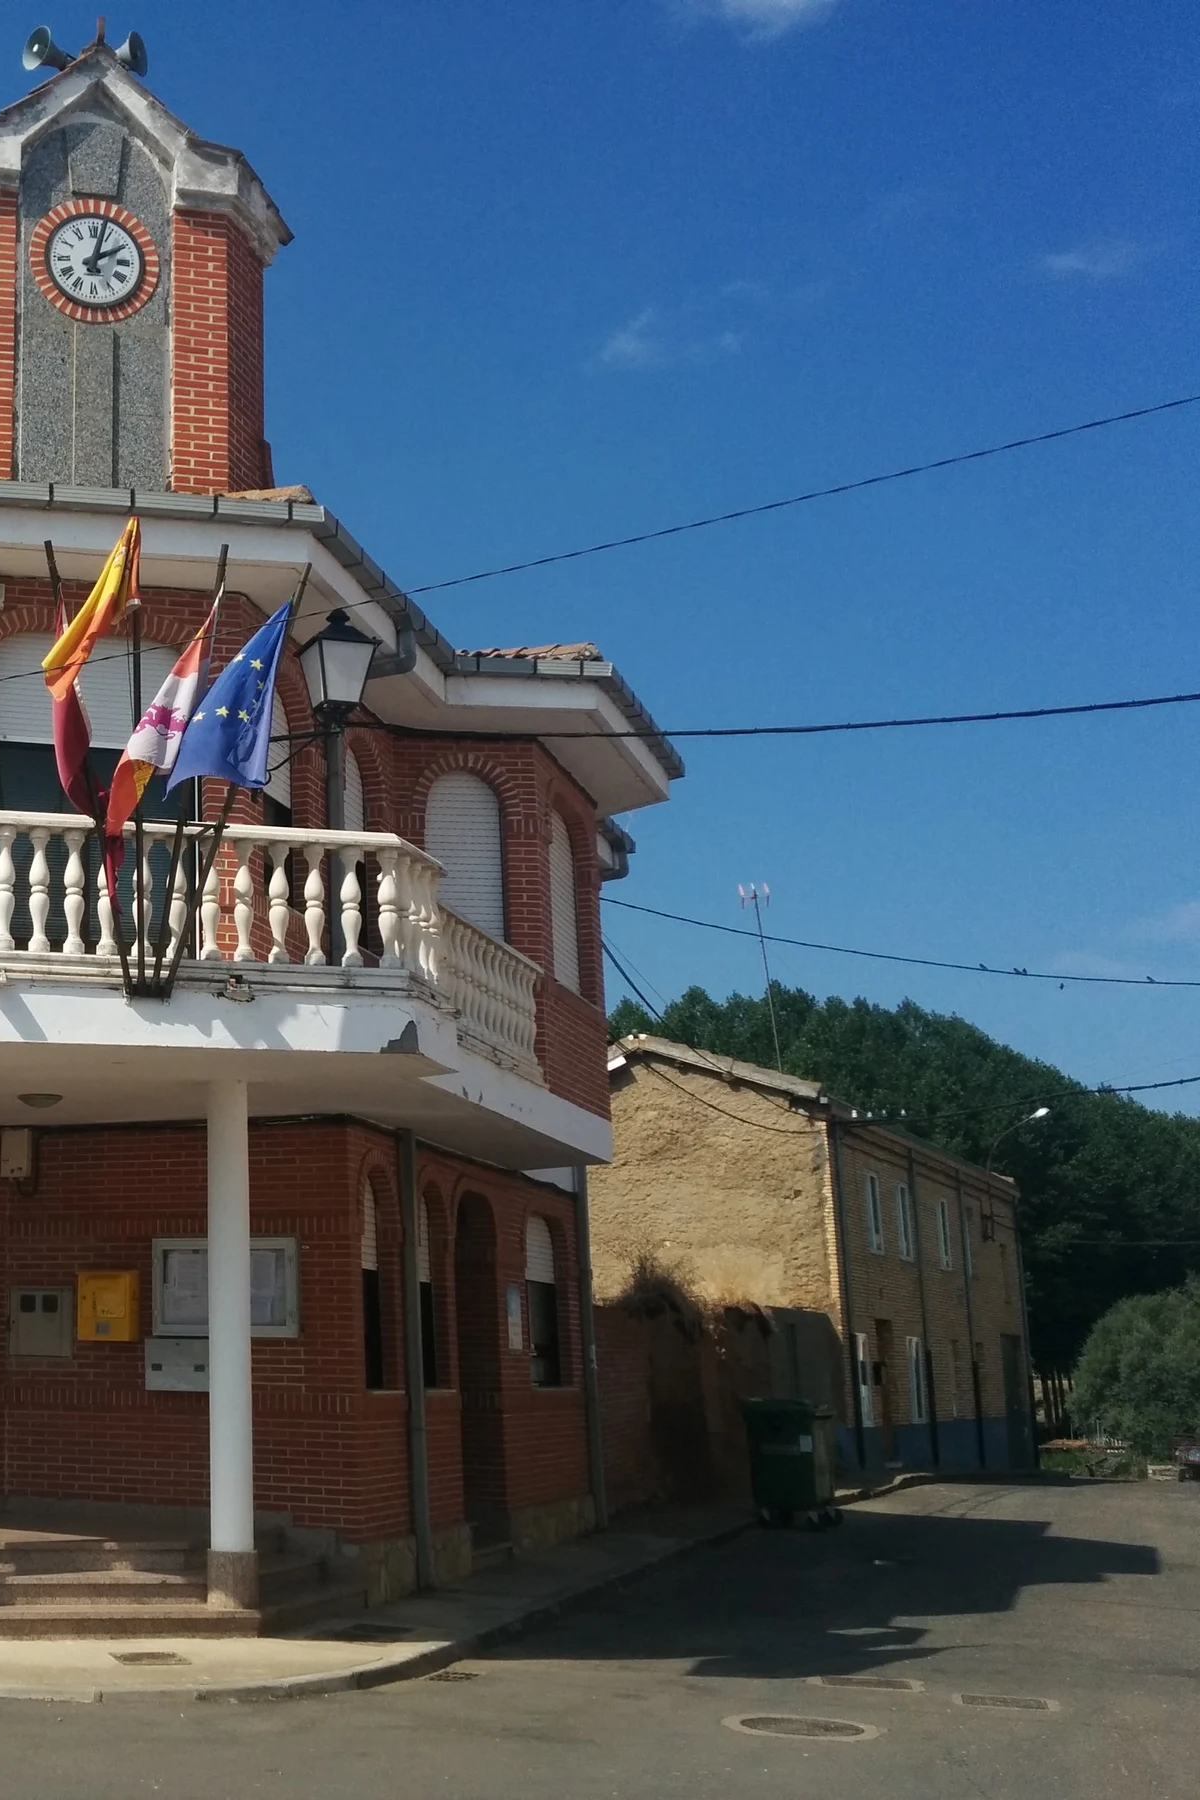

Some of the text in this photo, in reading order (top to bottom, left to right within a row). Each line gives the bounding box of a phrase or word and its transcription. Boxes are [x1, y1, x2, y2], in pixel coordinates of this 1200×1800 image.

[72, 228, 84, 241] XI
[88, 225, 99, 238] XII
[61, 238, 74, 249] X
[57, 253, 71, 261] IX
[116, 259, 130, 267] III
[60, 265, 75, 281] VIII
[72, 276, 84, 291] VII
[90, 281, 98, 295] VI
[106, 281, 115, 293] V
